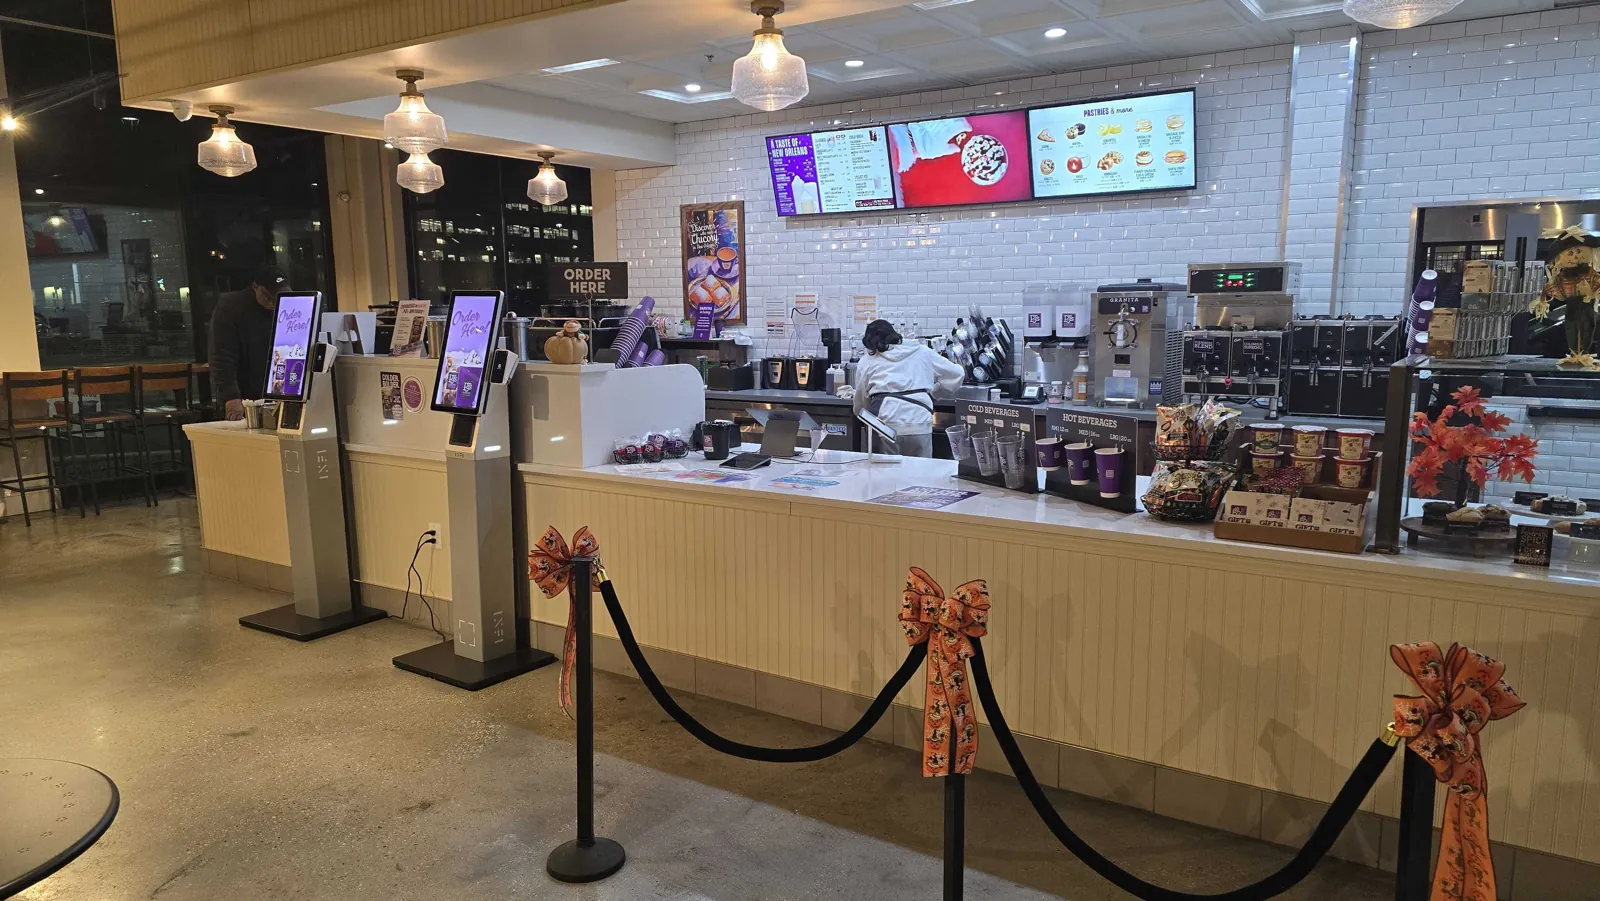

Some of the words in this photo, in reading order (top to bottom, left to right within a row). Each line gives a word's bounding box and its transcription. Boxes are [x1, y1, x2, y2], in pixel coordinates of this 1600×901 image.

[1084, 107, 1109, 117] PASTRIES
[771, 139, 775, 148] A
[775, 138, 791, 148] TASTE
[791, 138, 798, 147] OF
[772, 148, 784, 158] NEW
[785, 147, 808, 156] ORLEANS
[691, 223, 716, 233] Discover
[692, 233, 718, 246] Chicory
[564, 268, 611, 280] ORDER
[570, 282, 606, 293] HERE
[278, 308, 302, 323] Order
[452, 310, 480, 326] Order
[286, 318, 311, 334] Here!
[461, 321, 490, 338] Here!
[968, 404, 984, 414] COLD
[984, 406, 1019, 417] BEVERAGES
[1062, 413, 1077, 422] HOT
[1078, 415, 1118, 428] BEVERAGES
[1521, 535, 1548, 545] SPICE
